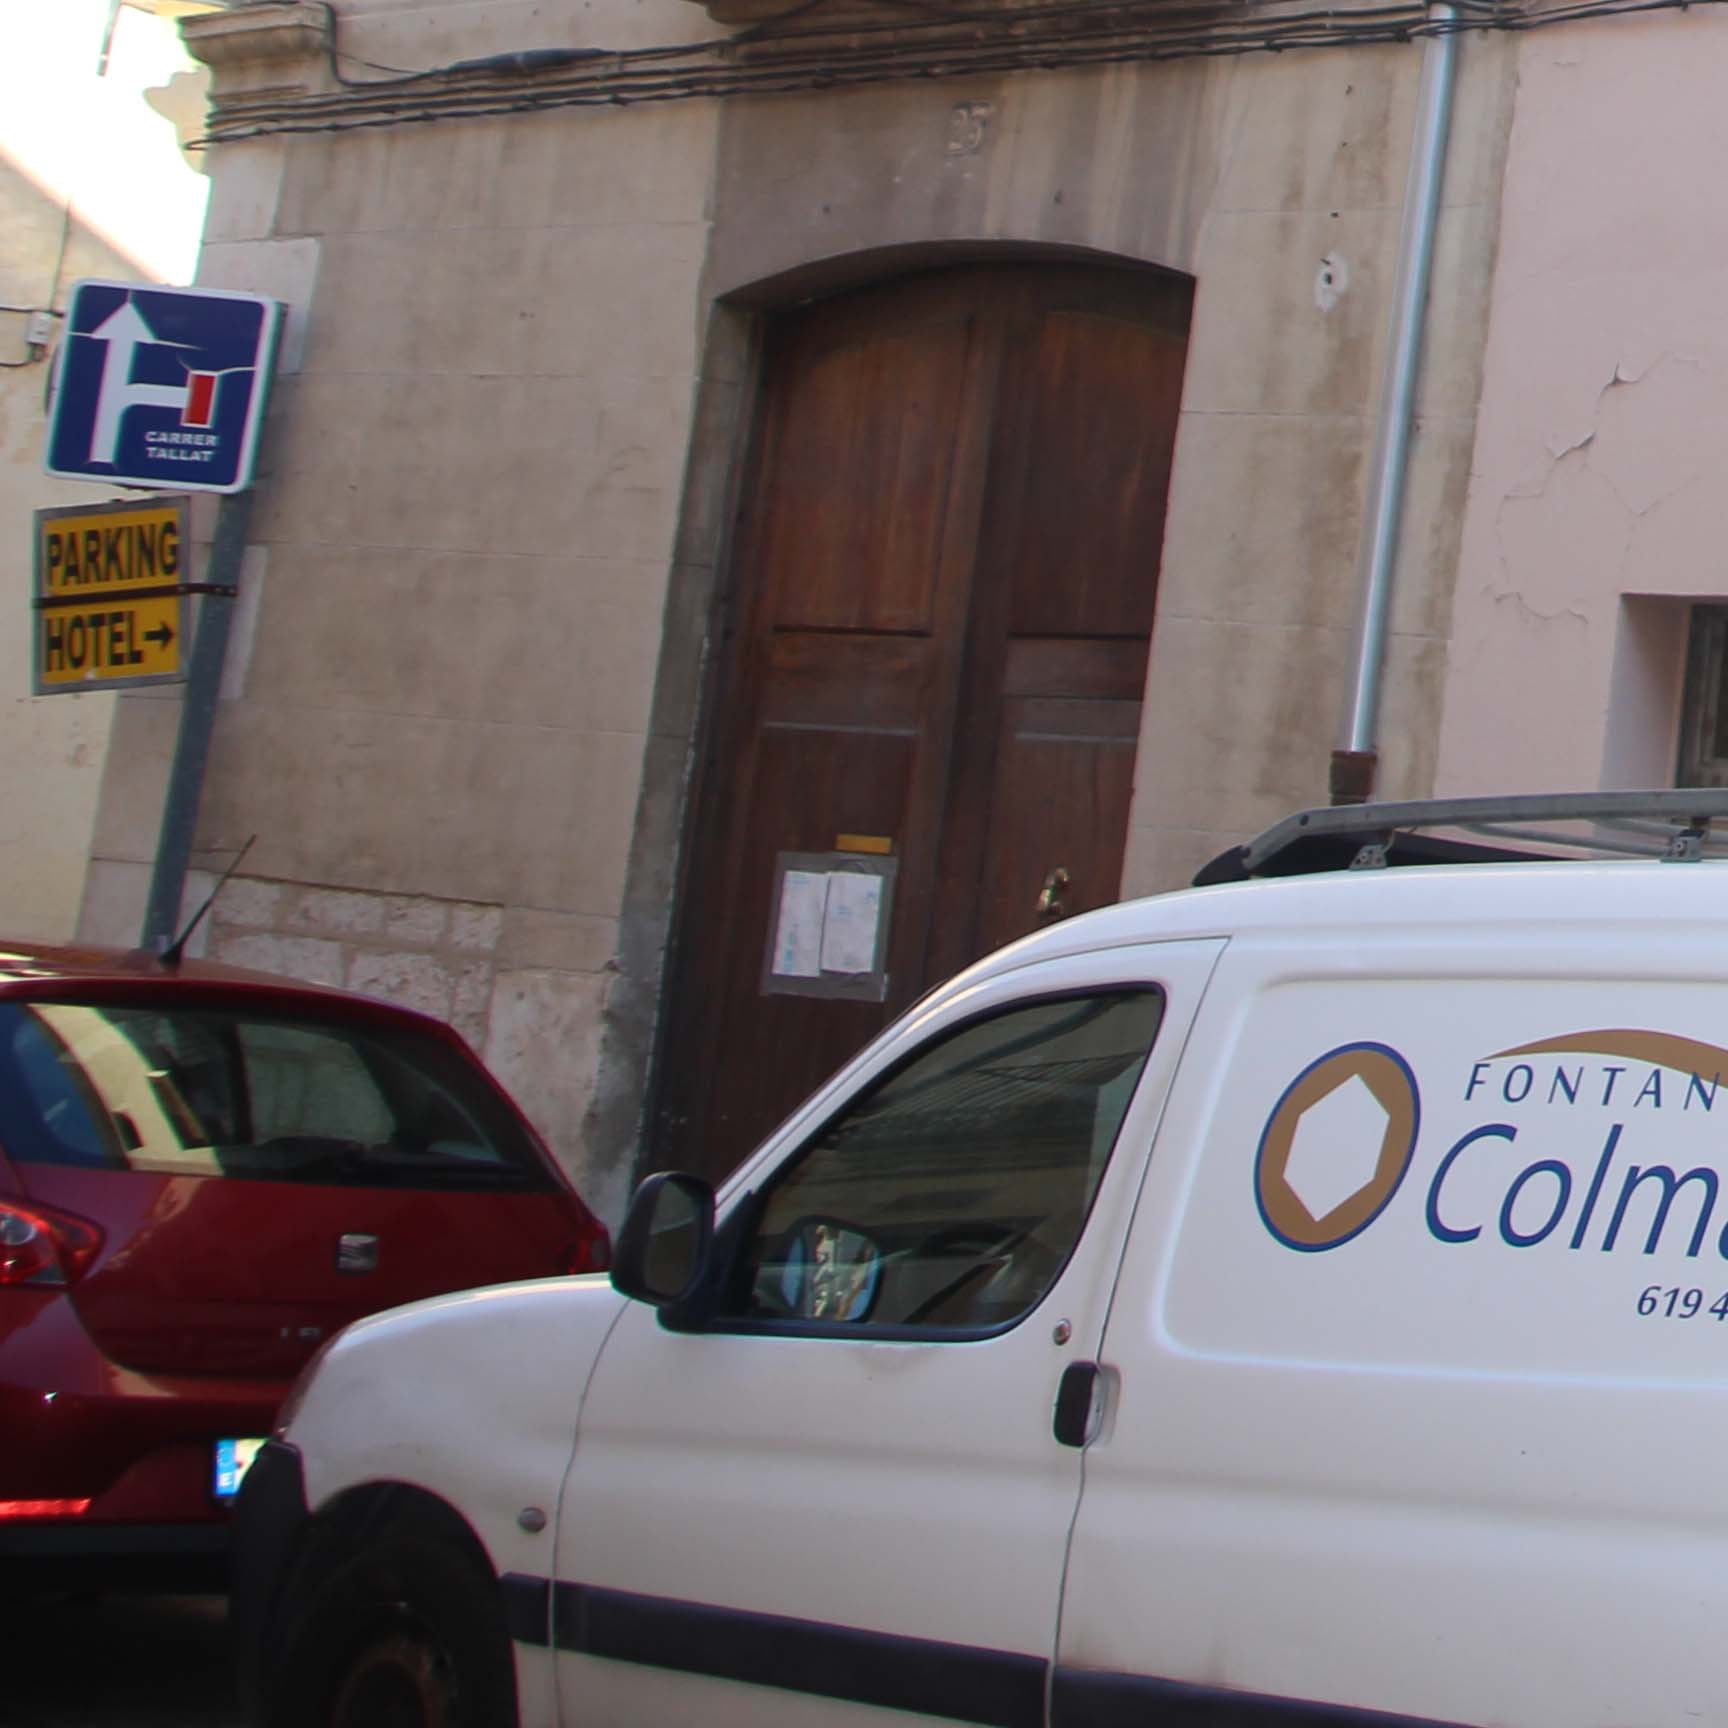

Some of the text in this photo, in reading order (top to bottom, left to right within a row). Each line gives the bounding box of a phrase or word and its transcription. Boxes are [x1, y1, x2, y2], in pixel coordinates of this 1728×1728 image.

[145, 432, 217, 446] CARRER
[146, 447, 214, 462] TALLAT
[46, 520, 178, 586] PARKING
[45, 610, 142, 671] HOTEL
[1637, 1285, 1704, 1319] 619
